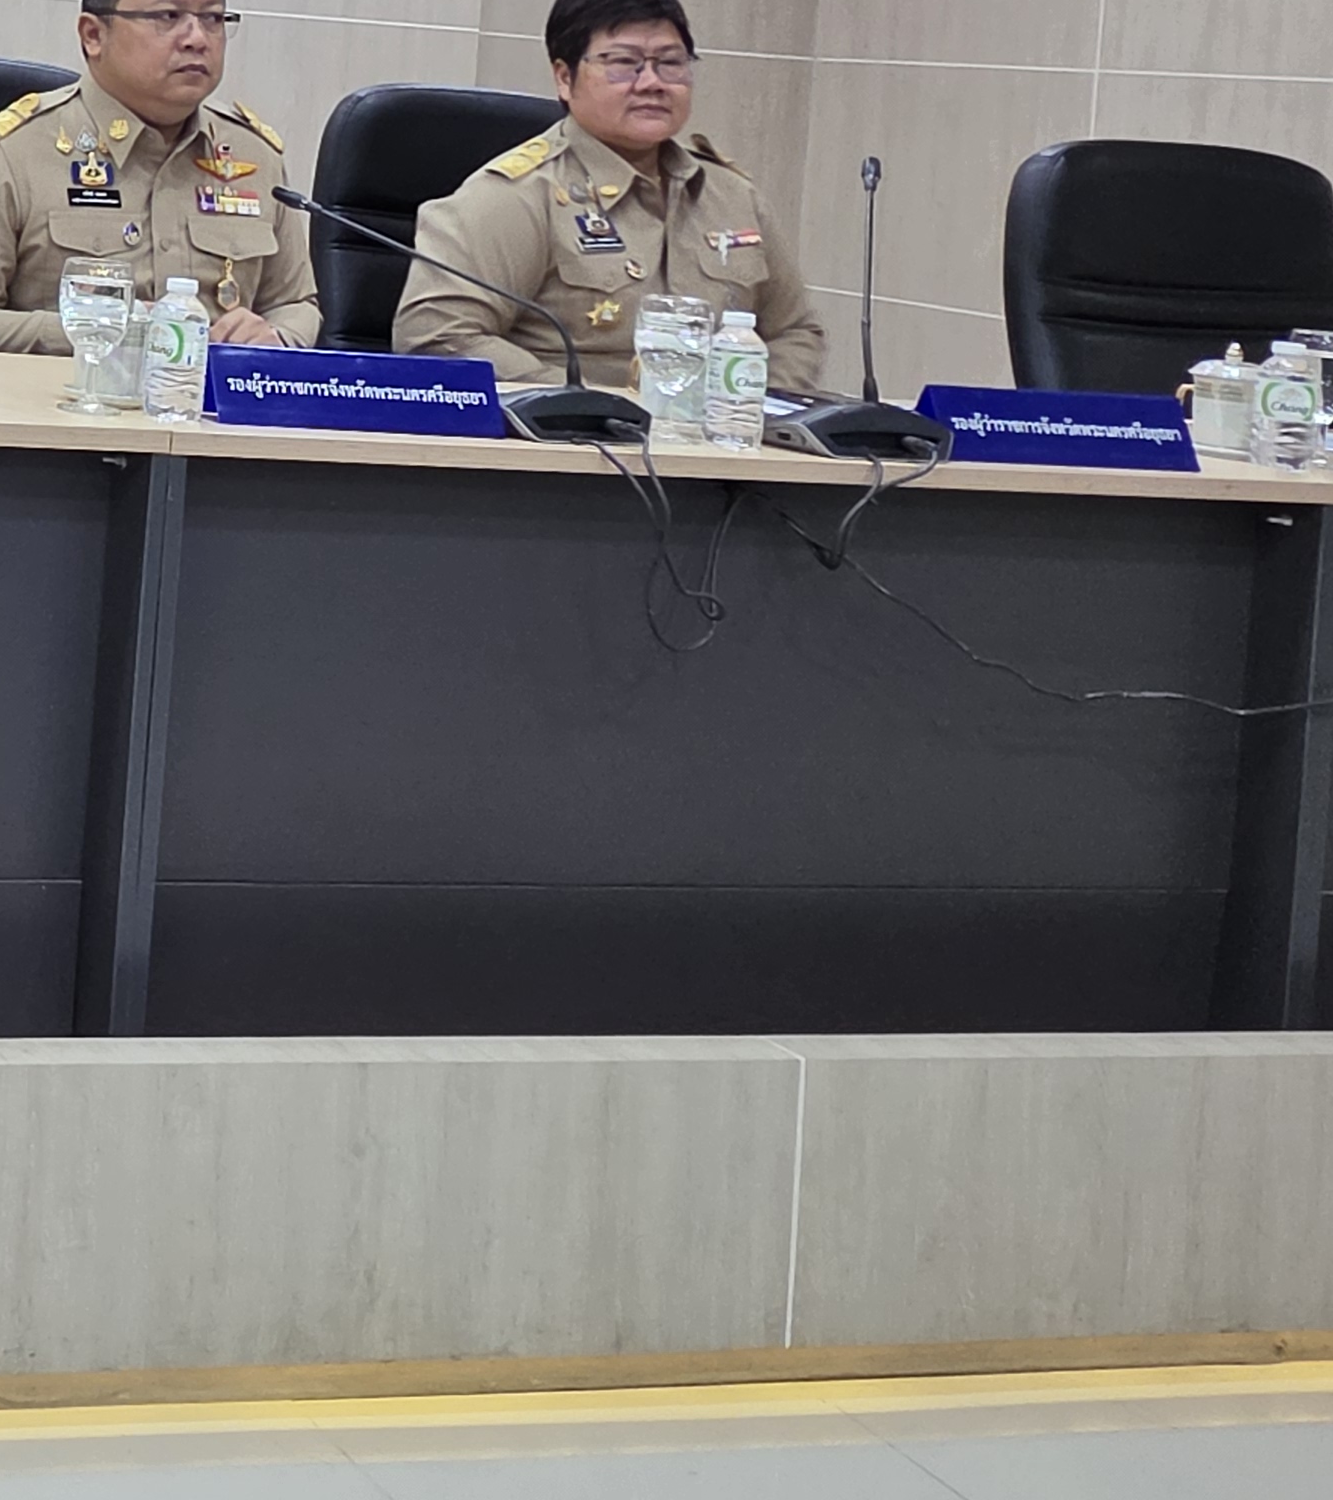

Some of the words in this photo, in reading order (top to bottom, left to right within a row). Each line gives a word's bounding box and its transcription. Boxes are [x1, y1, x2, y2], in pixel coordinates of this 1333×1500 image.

[226, 373, 488, 409] รองผู้ว่าราชการจังหวัดพระนครศรีอยุธยา
